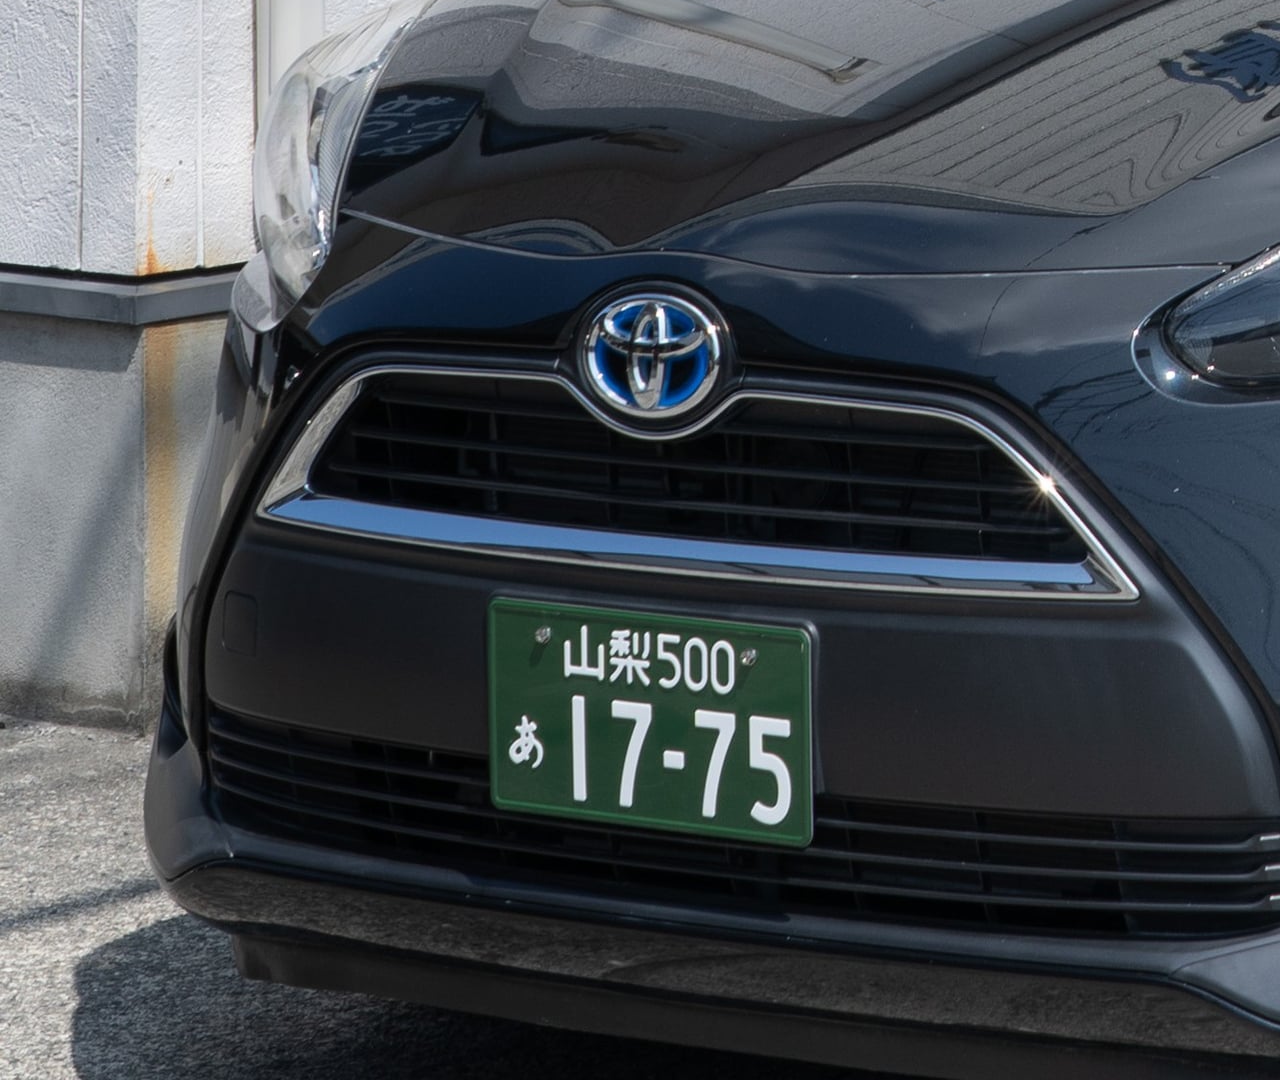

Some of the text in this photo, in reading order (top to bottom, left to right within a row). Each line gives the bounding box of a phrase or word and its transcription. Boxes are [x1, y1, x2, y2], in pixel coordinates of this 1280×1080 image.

[563, 625, 736, 696] 山梨500
[508, 695, 793, 826] あ 17-75
